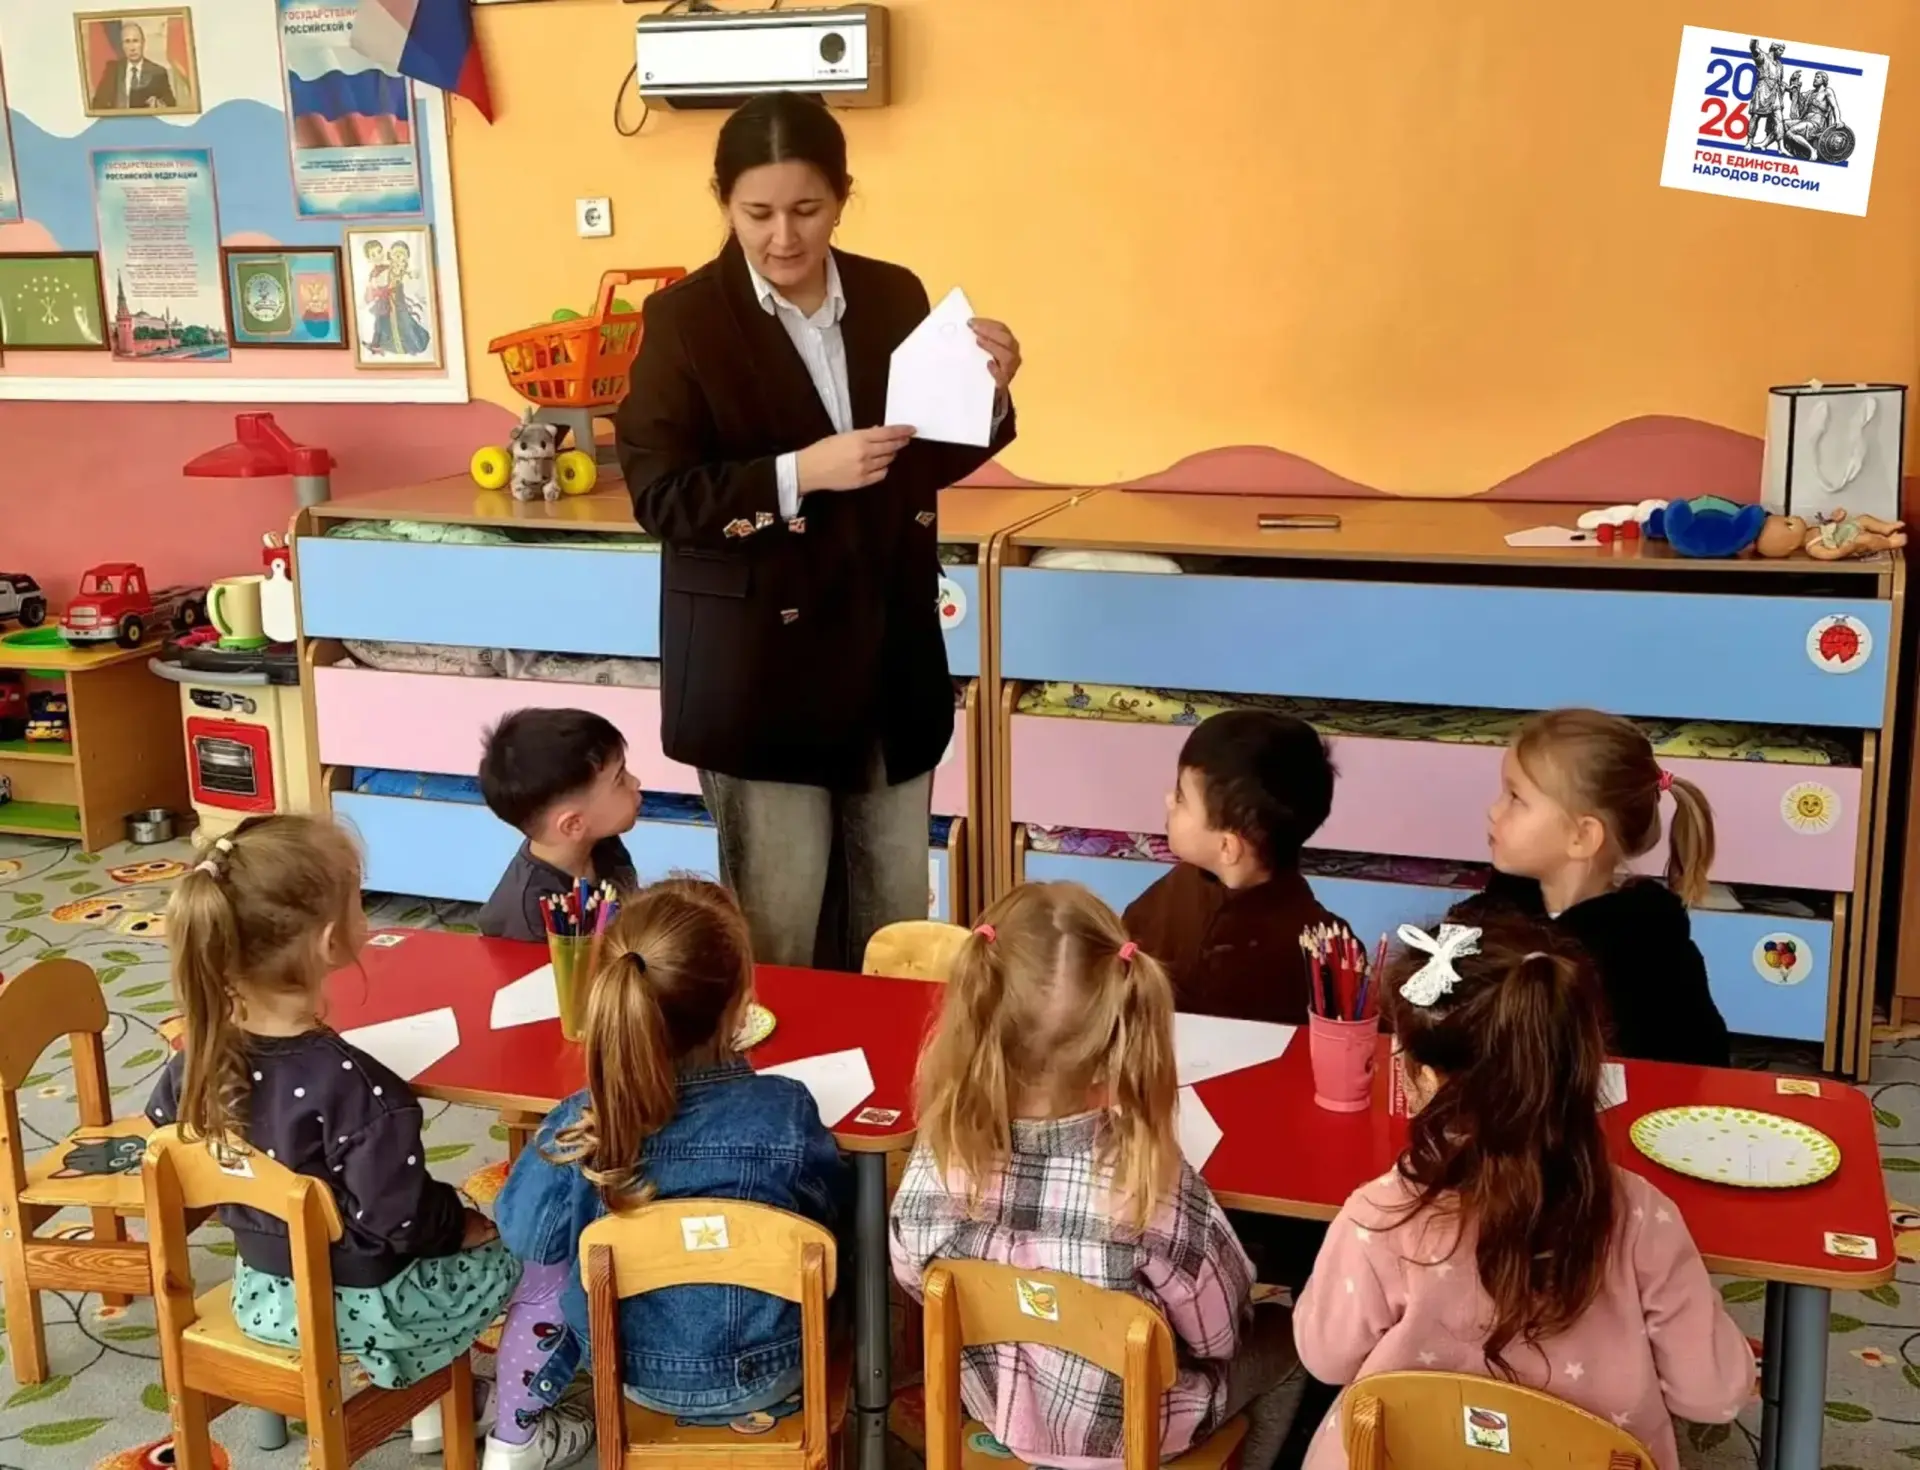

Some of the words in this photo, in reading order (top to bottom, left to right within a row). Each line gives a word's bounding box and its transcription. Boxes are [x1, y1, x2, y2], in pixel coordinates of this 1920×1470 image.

[284, 22, 344, 34] РОССИЙСКОЙ
[105, 172, 152, 180] РОССИЙСКОЙ
[154, 171, 198, 180] ФЕДЕРАЦИИ
